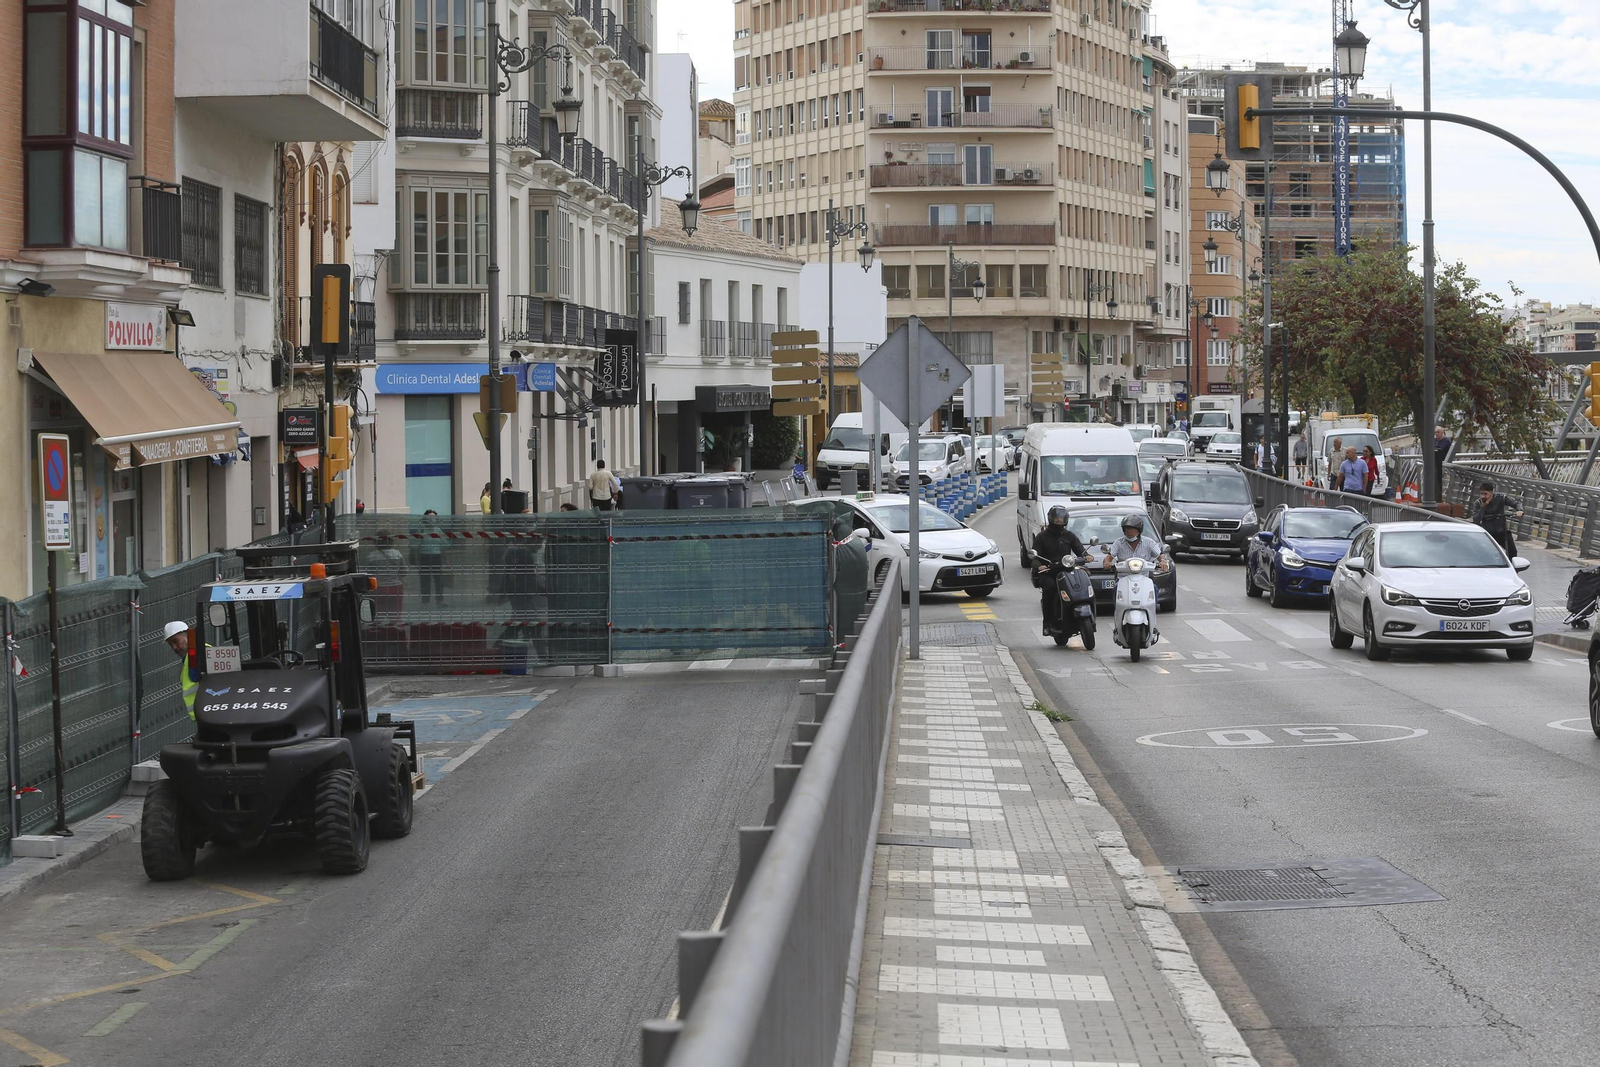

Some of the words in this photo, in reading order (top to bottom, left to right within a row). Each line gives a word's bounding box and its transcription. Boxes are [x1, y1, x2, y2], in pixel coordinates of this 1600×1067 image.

[1338, 114, 1347, 162] ANJOSE
[1338, 165, 1348, 246] CONSTRUCTORA
[108, 320, 154, 347] POLVILLO
[386, 373, 418, 384] Clínica
[420, 374, 452, 384] Dental
[454, 373, 481, 384] Adesl
[140, 439, 172, 460] PANADERÍA
[175, 434, 208, 456] CONFITERÍA
[234, 586, 281, 595] SAEZ
[1446, 622, 1468, 630] 6024
[1470, 622, 1487, 630] KDF
[206, 650, 212, 659] E
[215, 648, 237, 658] 8590
[214, 661, 231, 671] BDG
[203, 703, 229, 712] 655
[232, 702, 258, 710] 844
[262, 702, 288, 710] 545
